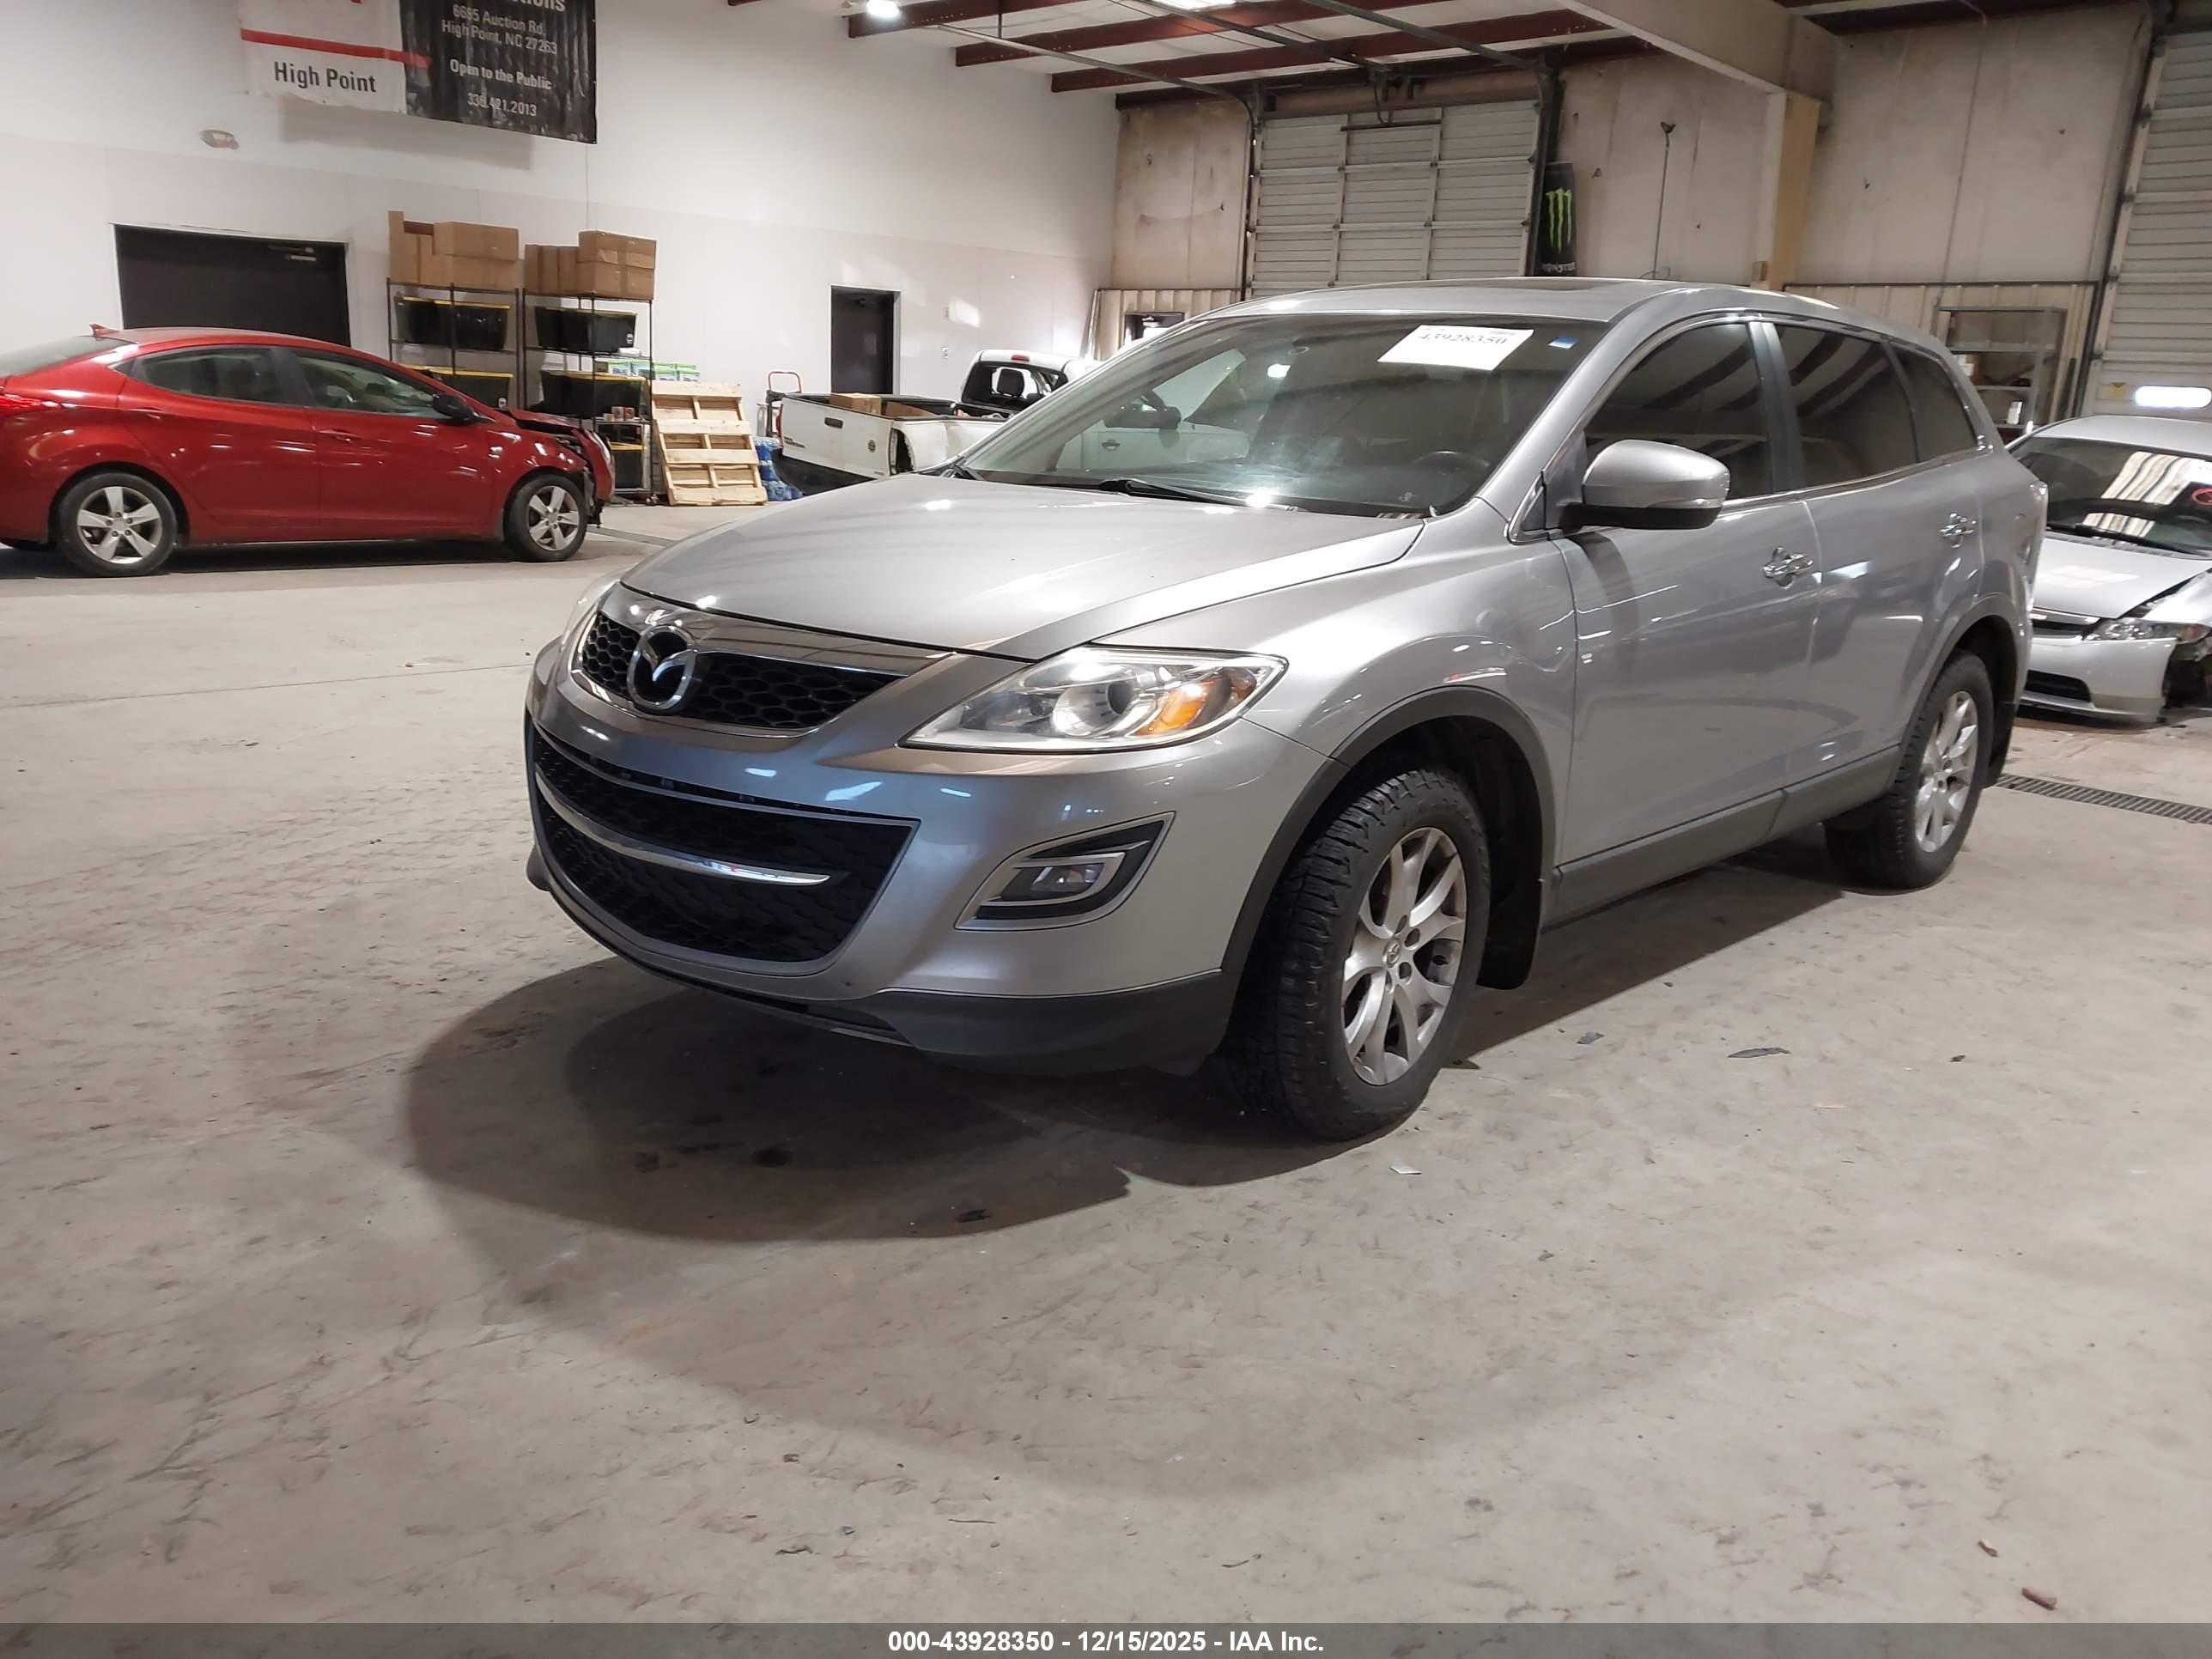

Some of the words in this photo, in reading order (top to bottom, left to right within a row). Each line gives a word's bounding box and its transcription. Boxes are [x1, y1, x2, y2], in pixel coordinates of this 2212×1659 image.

[483, 10, 526, 32] Auction
[441, 19, 470, 38] High
[505, 32, 523, 48] NC
[526, 36, 557, 55] 27263
[274, 61, 320, 89] High
[326, 68, 377, 92] Point
[450, 58, 479, 76] Open
[481, 66, 493, 79] to
[495, 68, 514, 83] the
[516, 71, 552, 90] Public
